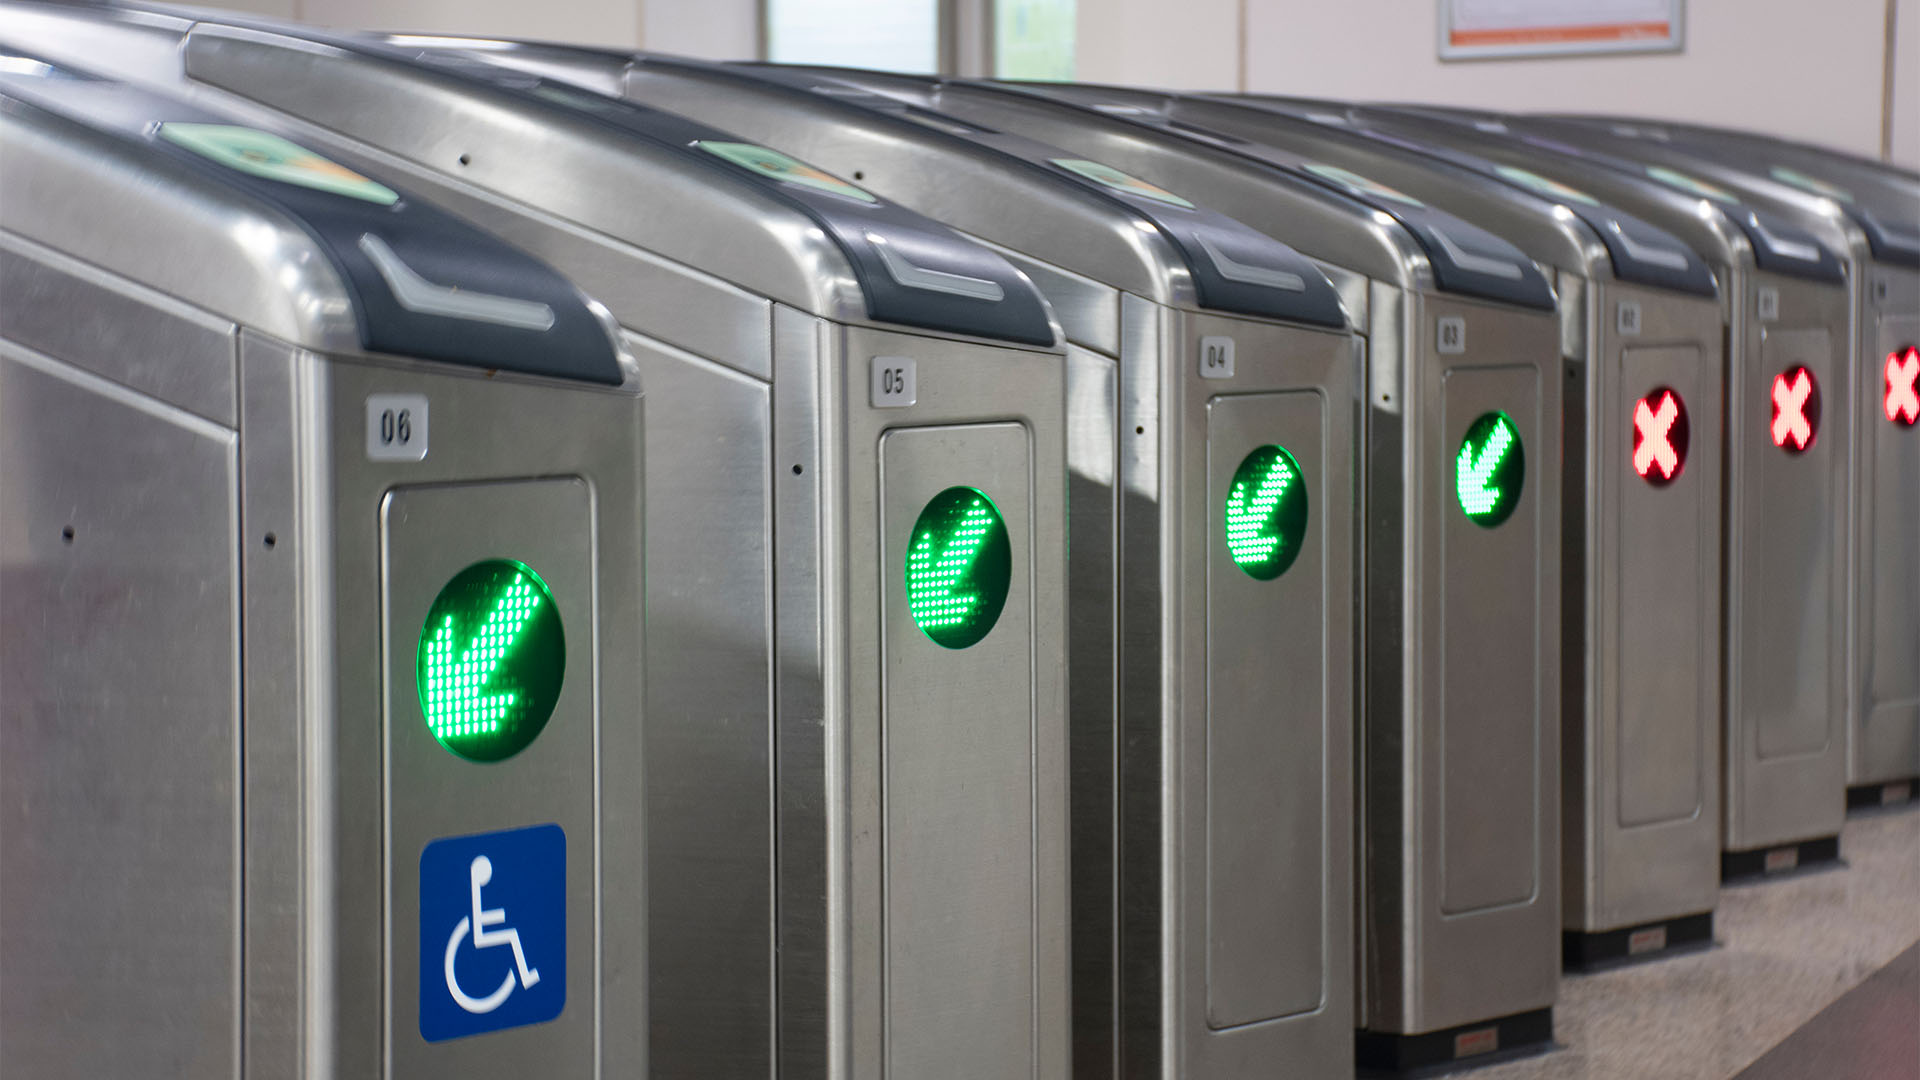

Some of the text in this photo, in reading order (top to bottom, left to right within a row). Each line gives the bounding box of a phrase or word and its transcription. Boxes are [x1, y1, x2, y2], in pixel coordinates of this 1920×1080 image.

[1444, 325, 1457, 345] 03
[1208, 345, 1225, 368] 04
[884, 368, 904, 394] 05
[382, 408, 411, 445] 06
